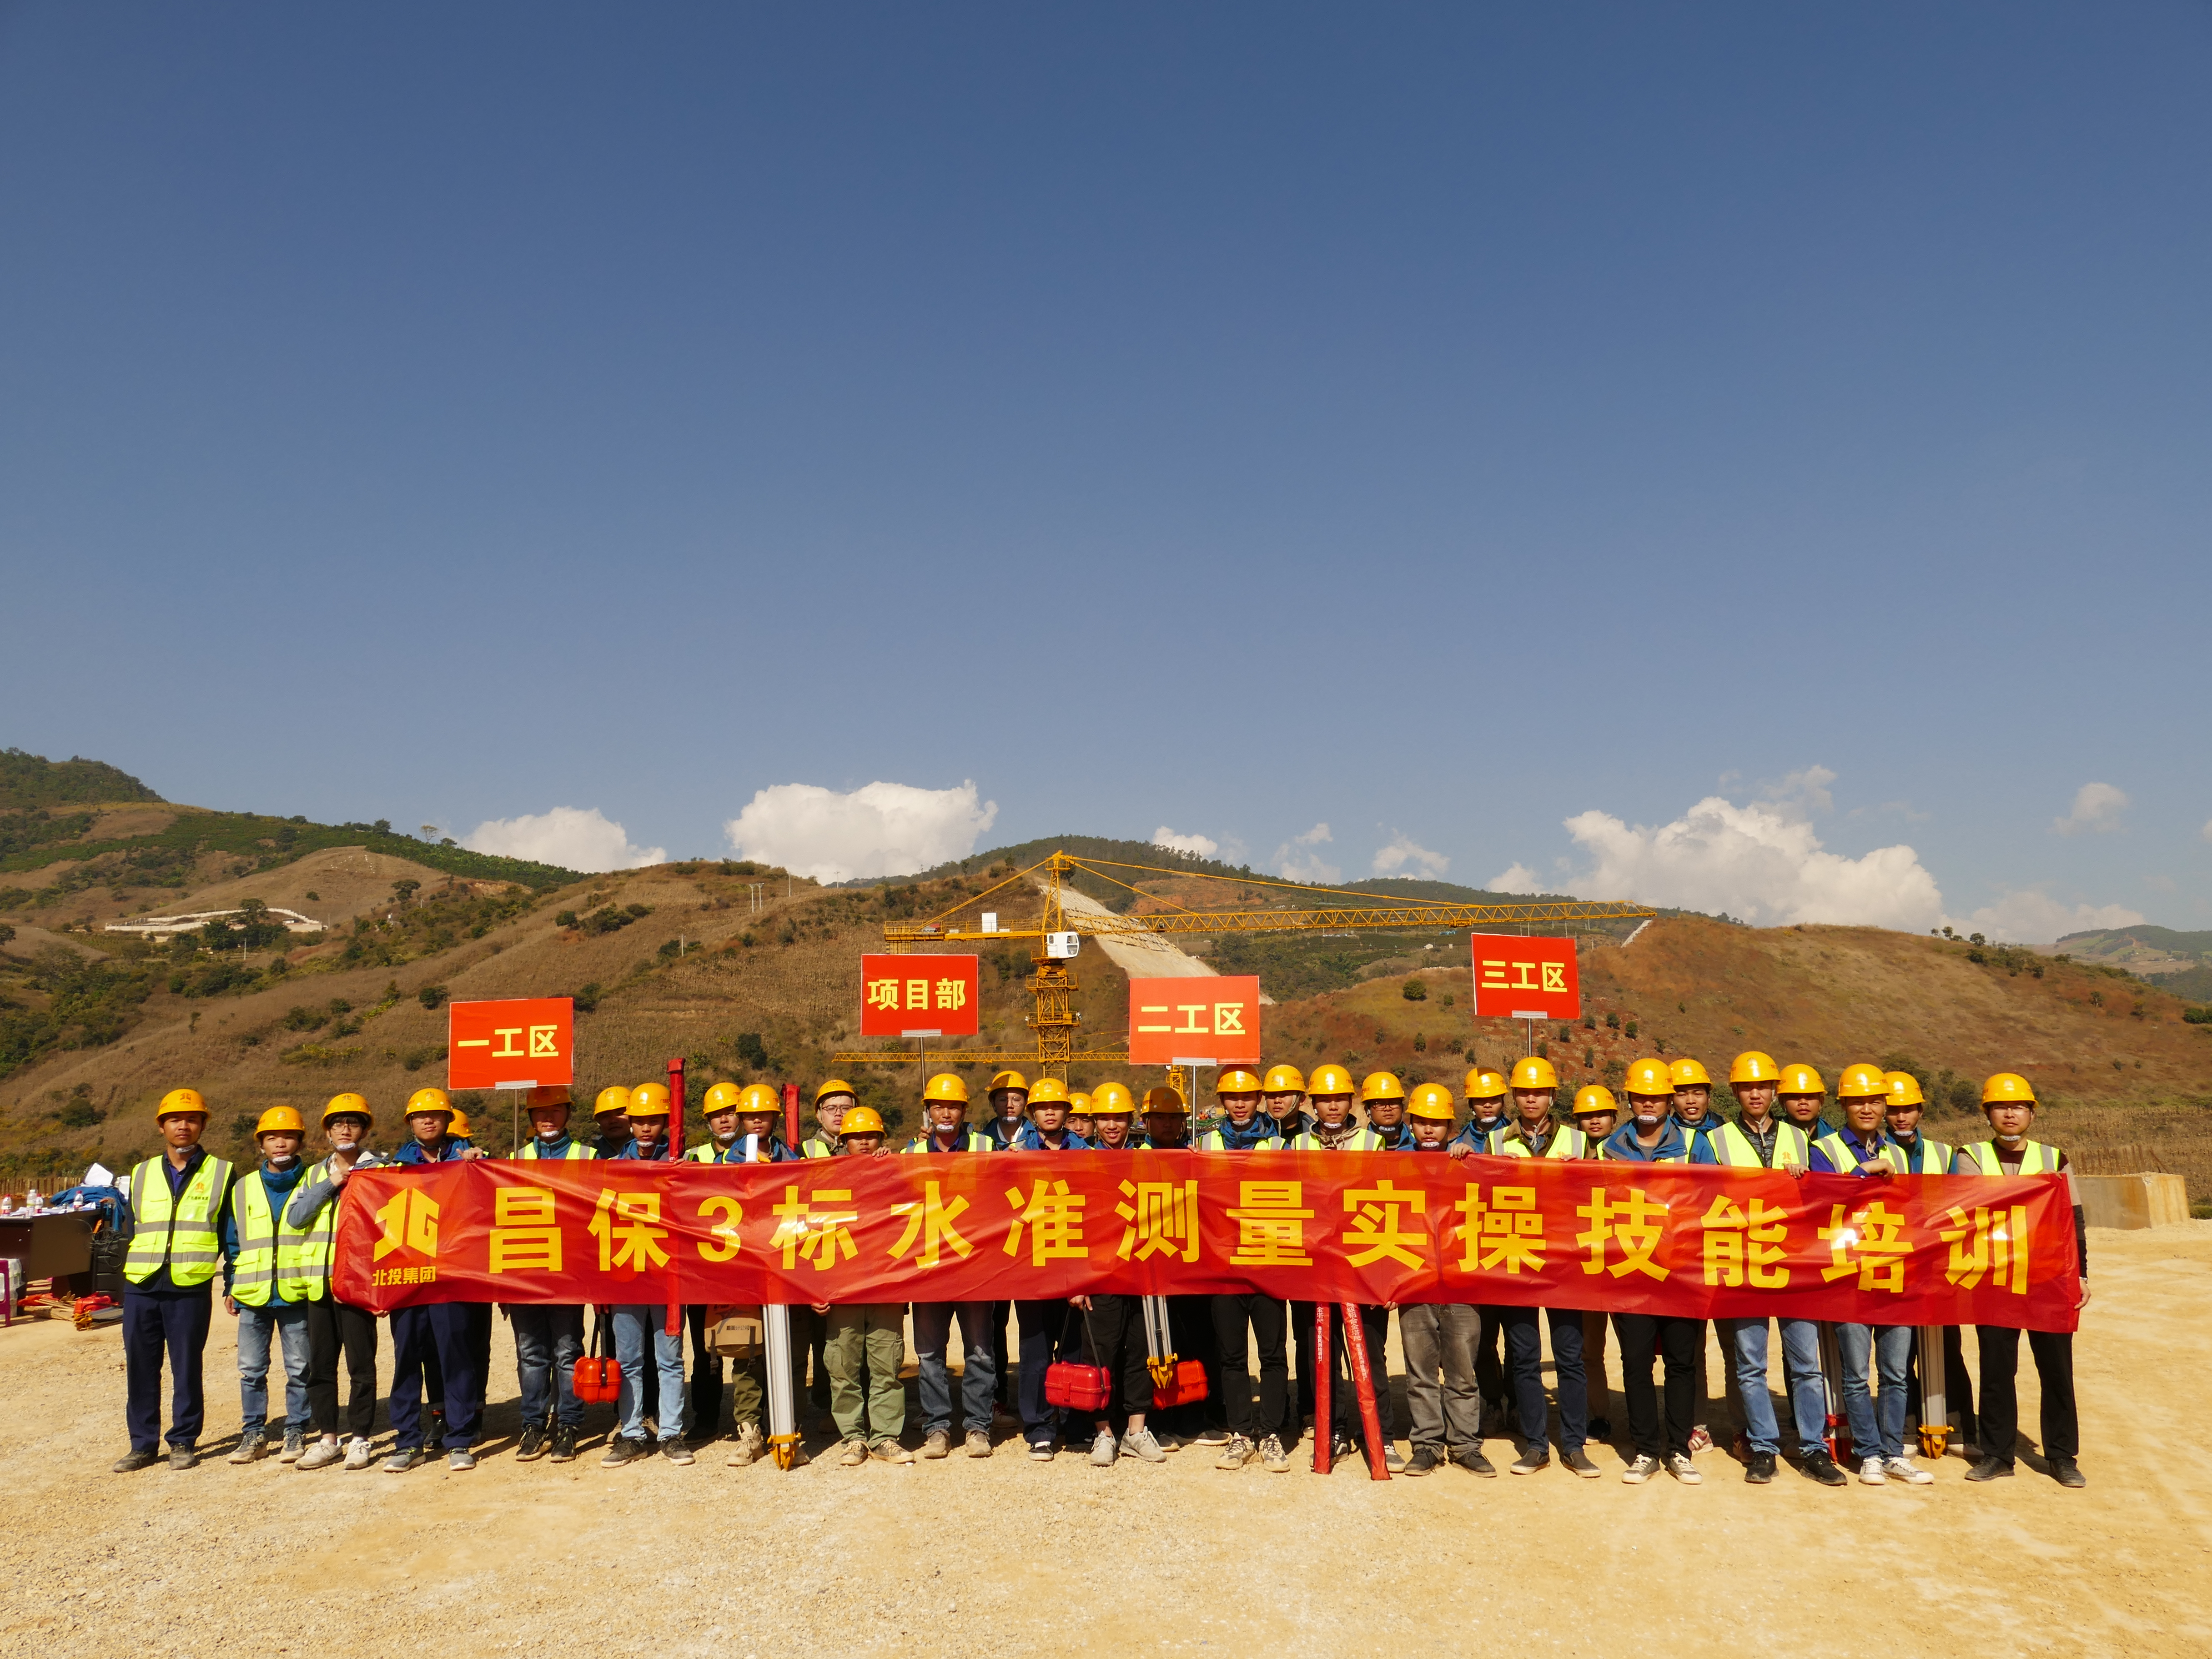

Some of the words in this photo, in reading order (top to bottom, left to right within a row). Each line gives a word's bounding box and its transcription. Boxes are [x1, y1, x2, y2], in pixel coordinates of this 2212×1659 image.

[1481, 960, 1568, 992] 三工区
[867, 978, 966, 1010] 项目部
[1138, 1003, 1246, 1035] 二工区
[457, 1025, 559, 1058] 一工区
[489, 1179, 2028, 1295] 昌保3标水准测量实操技能培训
[372, 1266, 436, 1286] 北投集团
